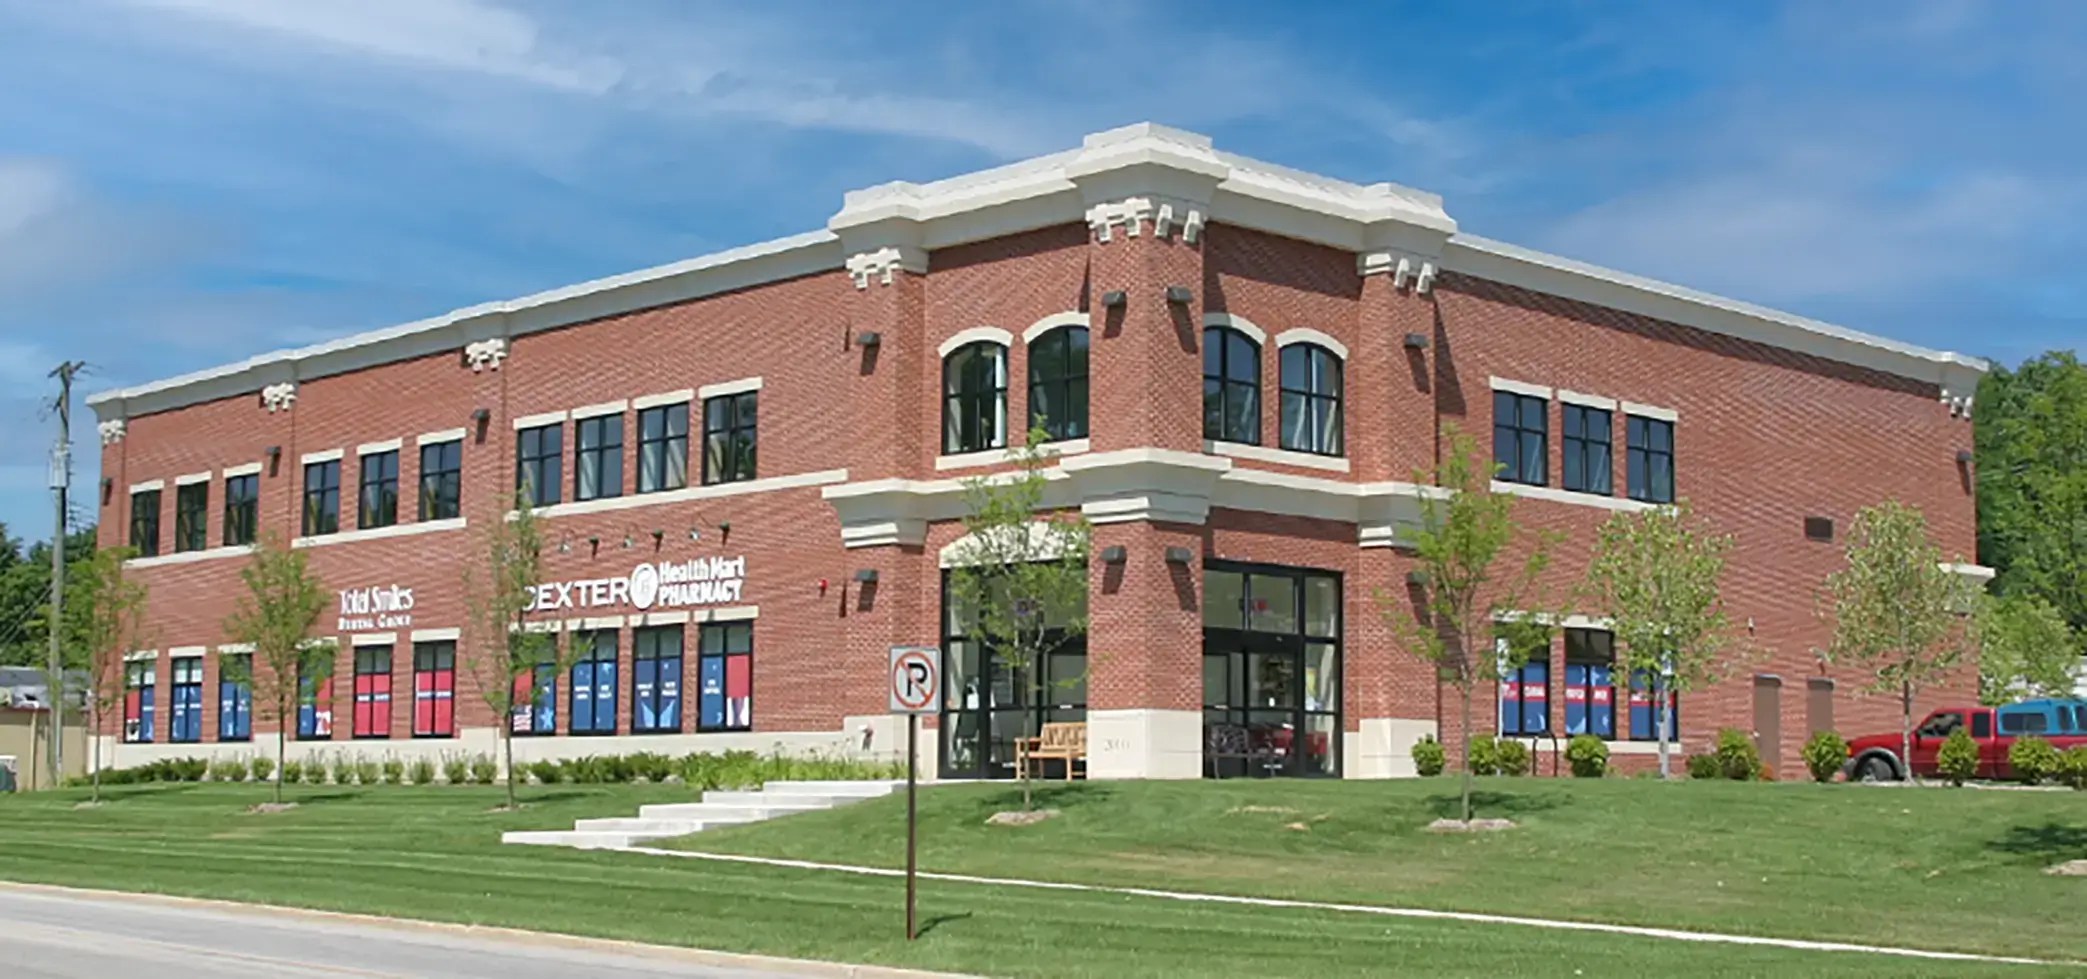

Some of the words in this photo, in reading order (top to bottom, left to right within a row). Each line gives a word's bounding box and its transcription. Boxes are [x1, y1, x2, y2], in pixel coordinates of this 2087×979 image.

[659, 558, 709, 583] Health
[710, 555, 745, 580] Mart
[338, 587, 370, 614] Total
[371, 584, 414, 614] Smiles
[658, 579, 743, 607] PHARMACY
[907, 663, 928, 697] P
